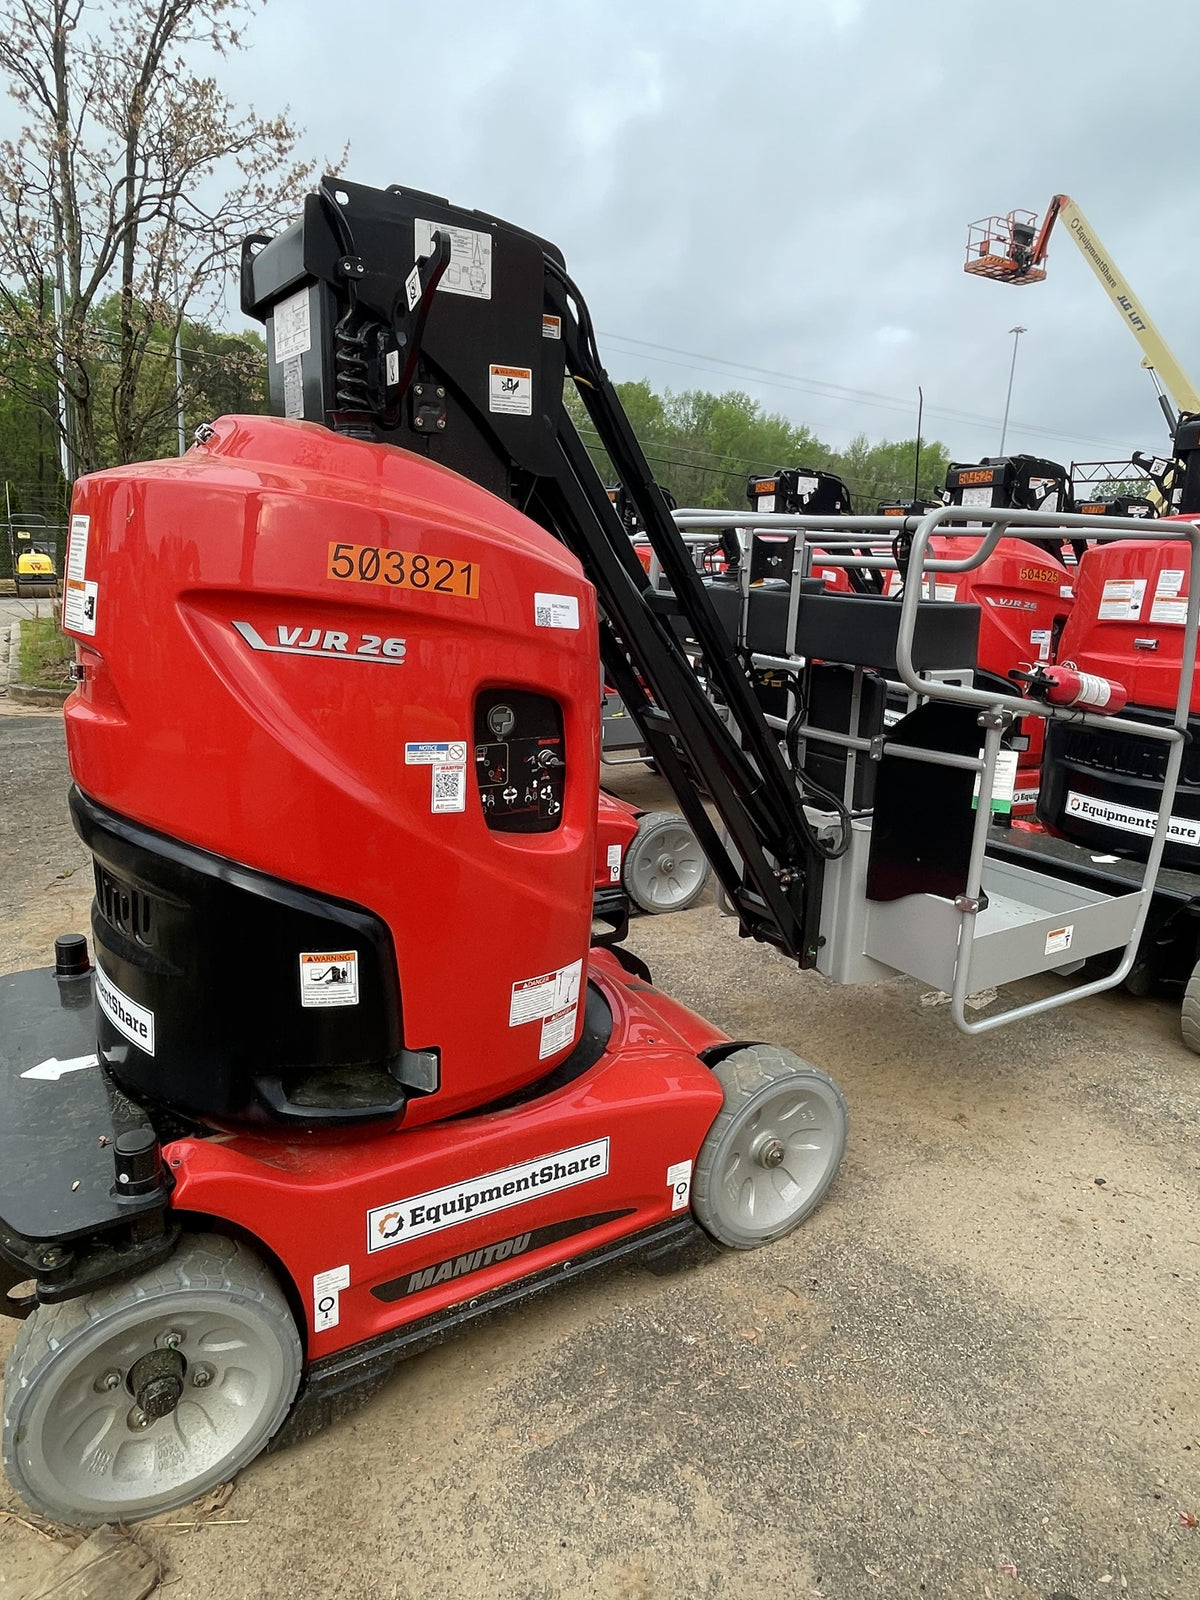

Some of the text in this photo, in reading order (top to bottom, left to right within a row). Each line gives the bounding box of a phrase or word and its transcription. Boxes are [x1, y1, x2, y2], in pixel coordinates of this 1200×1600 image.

[1075, 225, 1117, 288] EquipmentShare
[1116, 295, 1147, 331] JLG LIFT
[331, 543, 473, 596] 503821
[1020, 568, 1059, 583] 504525
[998, 597, 1038, 609] VJR 26
[277, 625, 407, 657] VJR 26
[1081, 802, 1197, 838] EquipmentSare
[527, 976, 550, 988] DANGER
[409, 1153, 601, 1228] EquipmentShare
[407, 1232, 531, 1294] MANITOU
